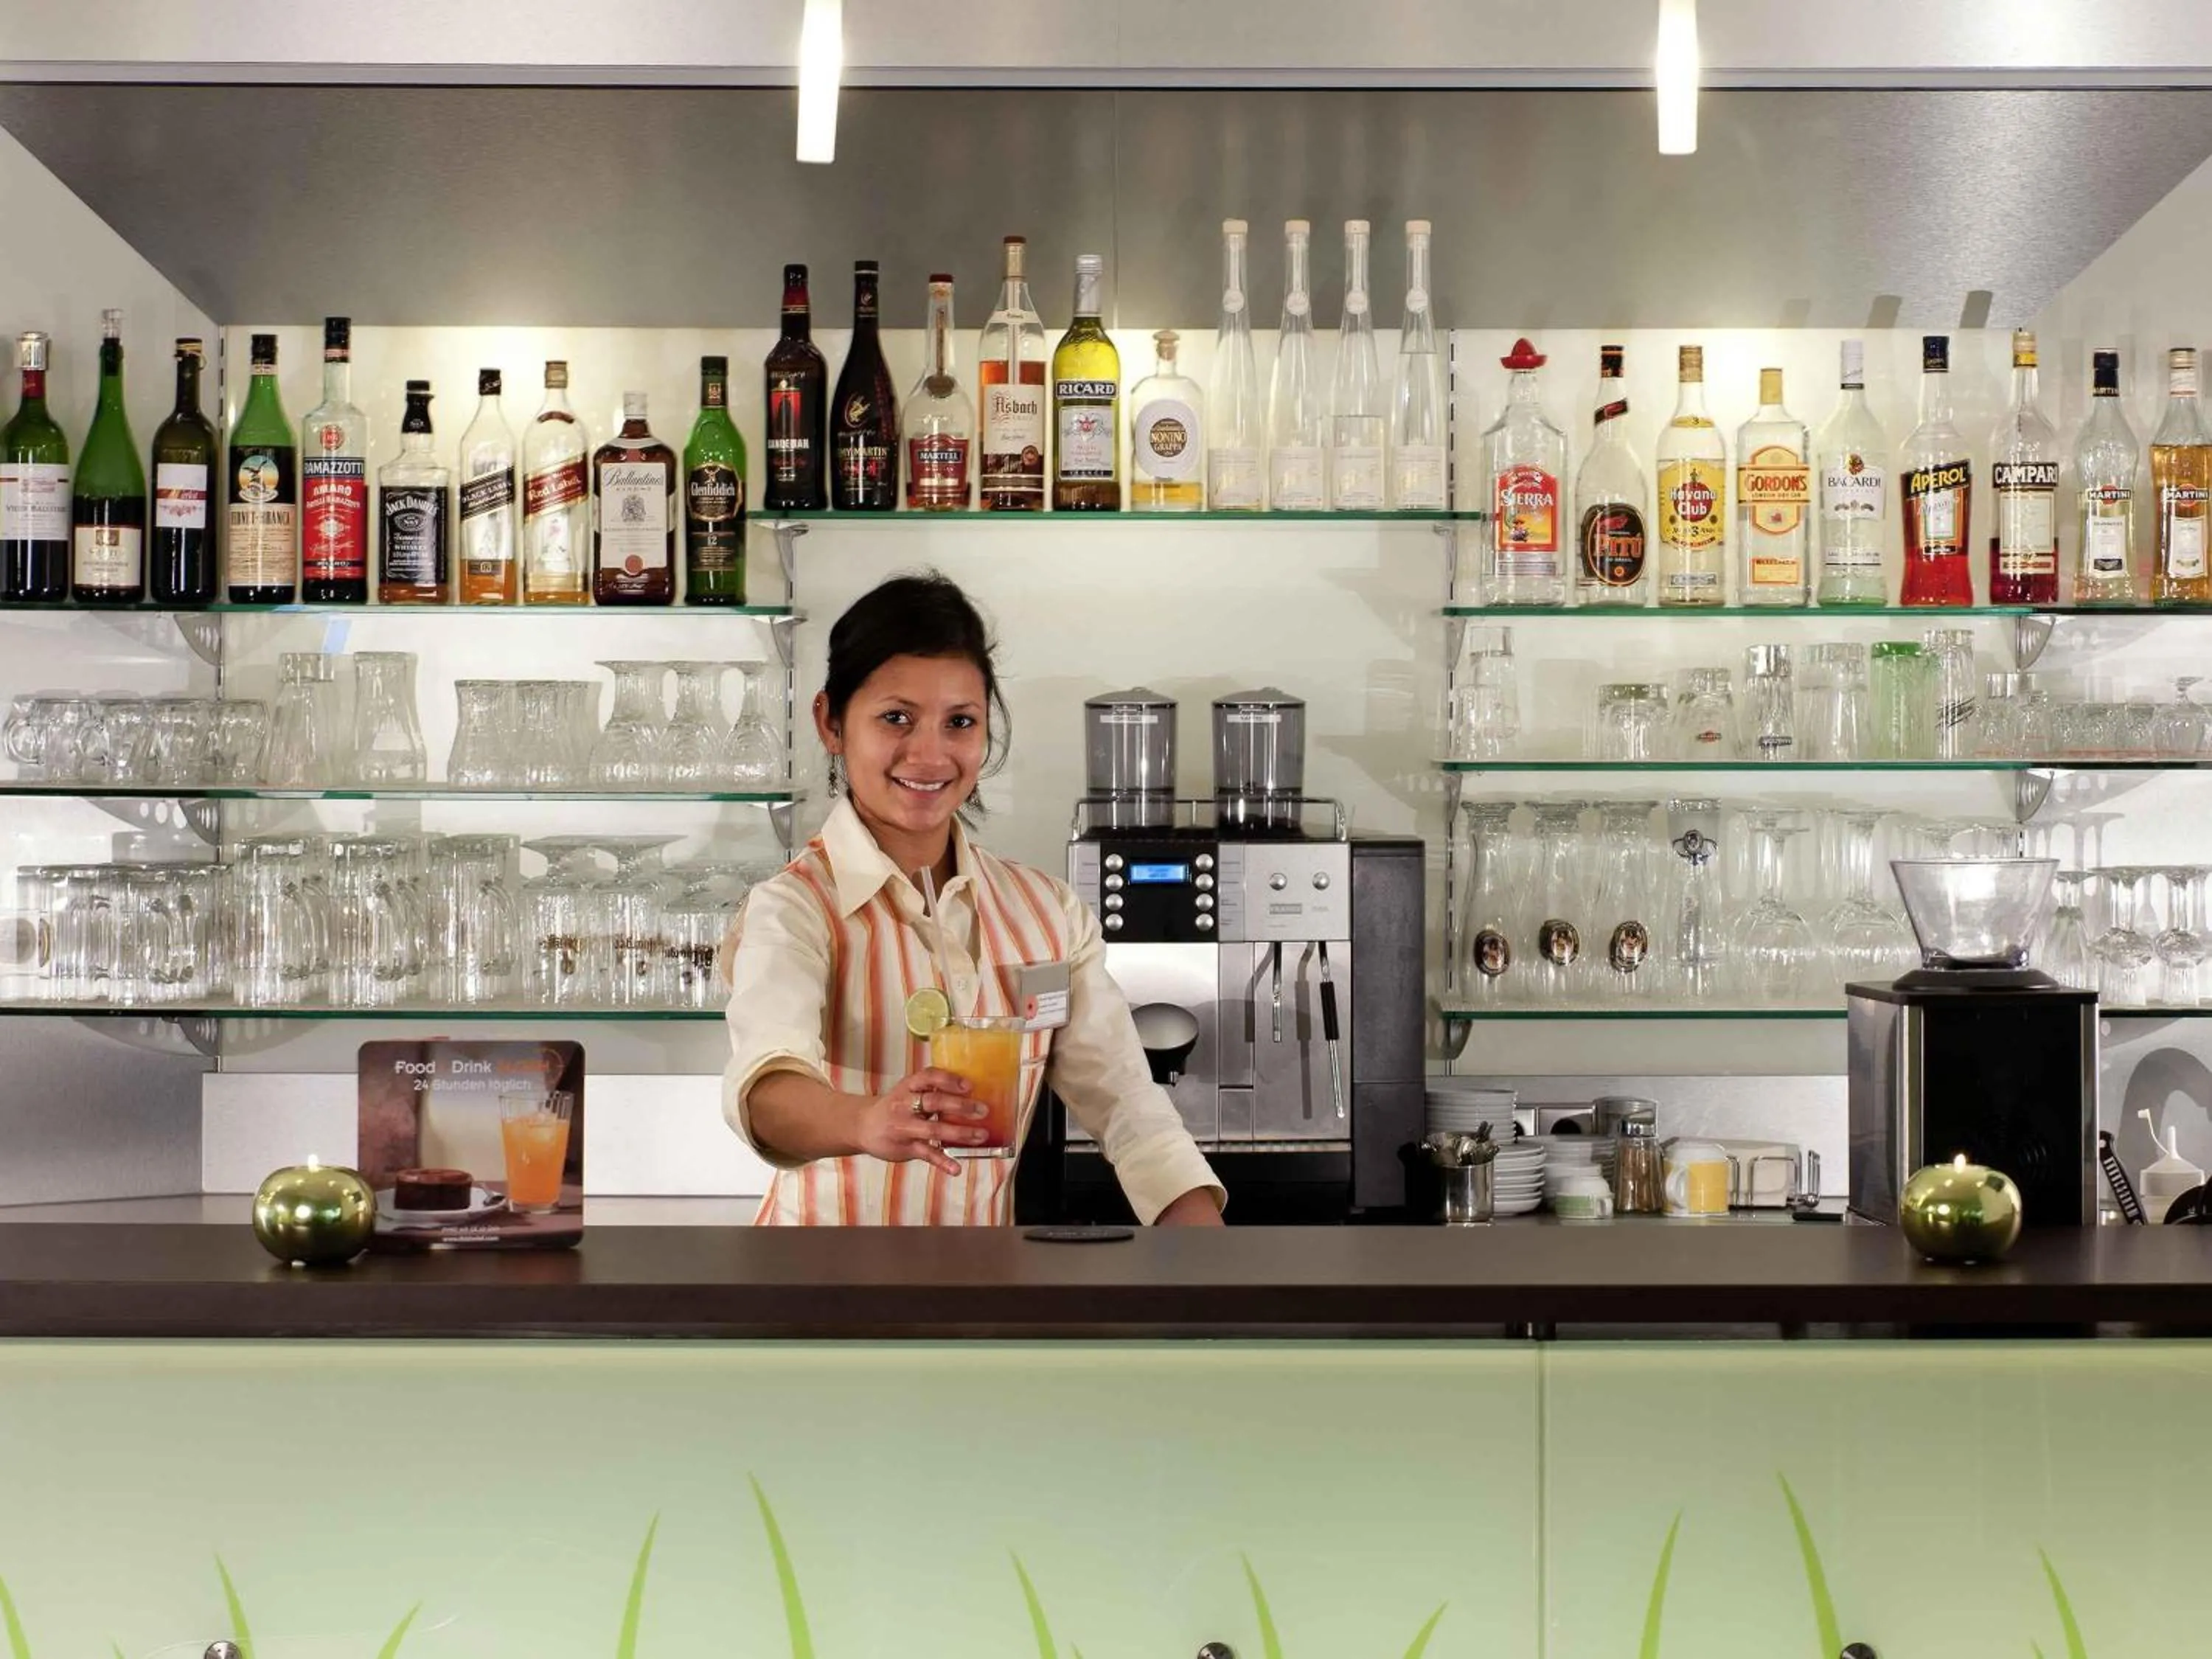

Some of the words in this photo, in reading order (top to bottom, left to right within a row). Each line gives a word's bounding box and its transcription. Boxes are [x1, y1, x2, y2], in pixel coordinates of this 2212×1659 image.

[1060, 383, 1115, 394] RICARD
[995, 396, 1037, 416] Asbach
[1151, 431, 1186, 443] NONINO
[919, 452, 959, 461] MARTELL
[304, 460, 364, 474] RAMAZZOTTI
[1910, 467, 1966, 493] APEROL
[1994, 465, 2057, 484] CAMPARI
[528, 486, 550, 501] Red
[552, 476, 581, 493] Label
[691, 481, 736, 497] Glenfiddich
[1746, 473, 1807, 492] GORDON'S
[1828, 477, 1881, 487] BACARDI
[313, 483, 352, 497] AMARO
[1669, 487, 1717, 501] Havana
[2088, 491, 2130, 499] MARTINI
[2167, 490, 2208, 499] MARTINI
[1500, 488, 1554, 507] SIERRA
[386, 498, 406, 516] JACK
[1677, 503, 1708, 515] Club
[394, 1060, 436, 1074] Food
[451, 1060, 492, 1074] Drink
[414, 1079, 429, 1091] 24
[432, 1079, 486, 1091] Stunden
